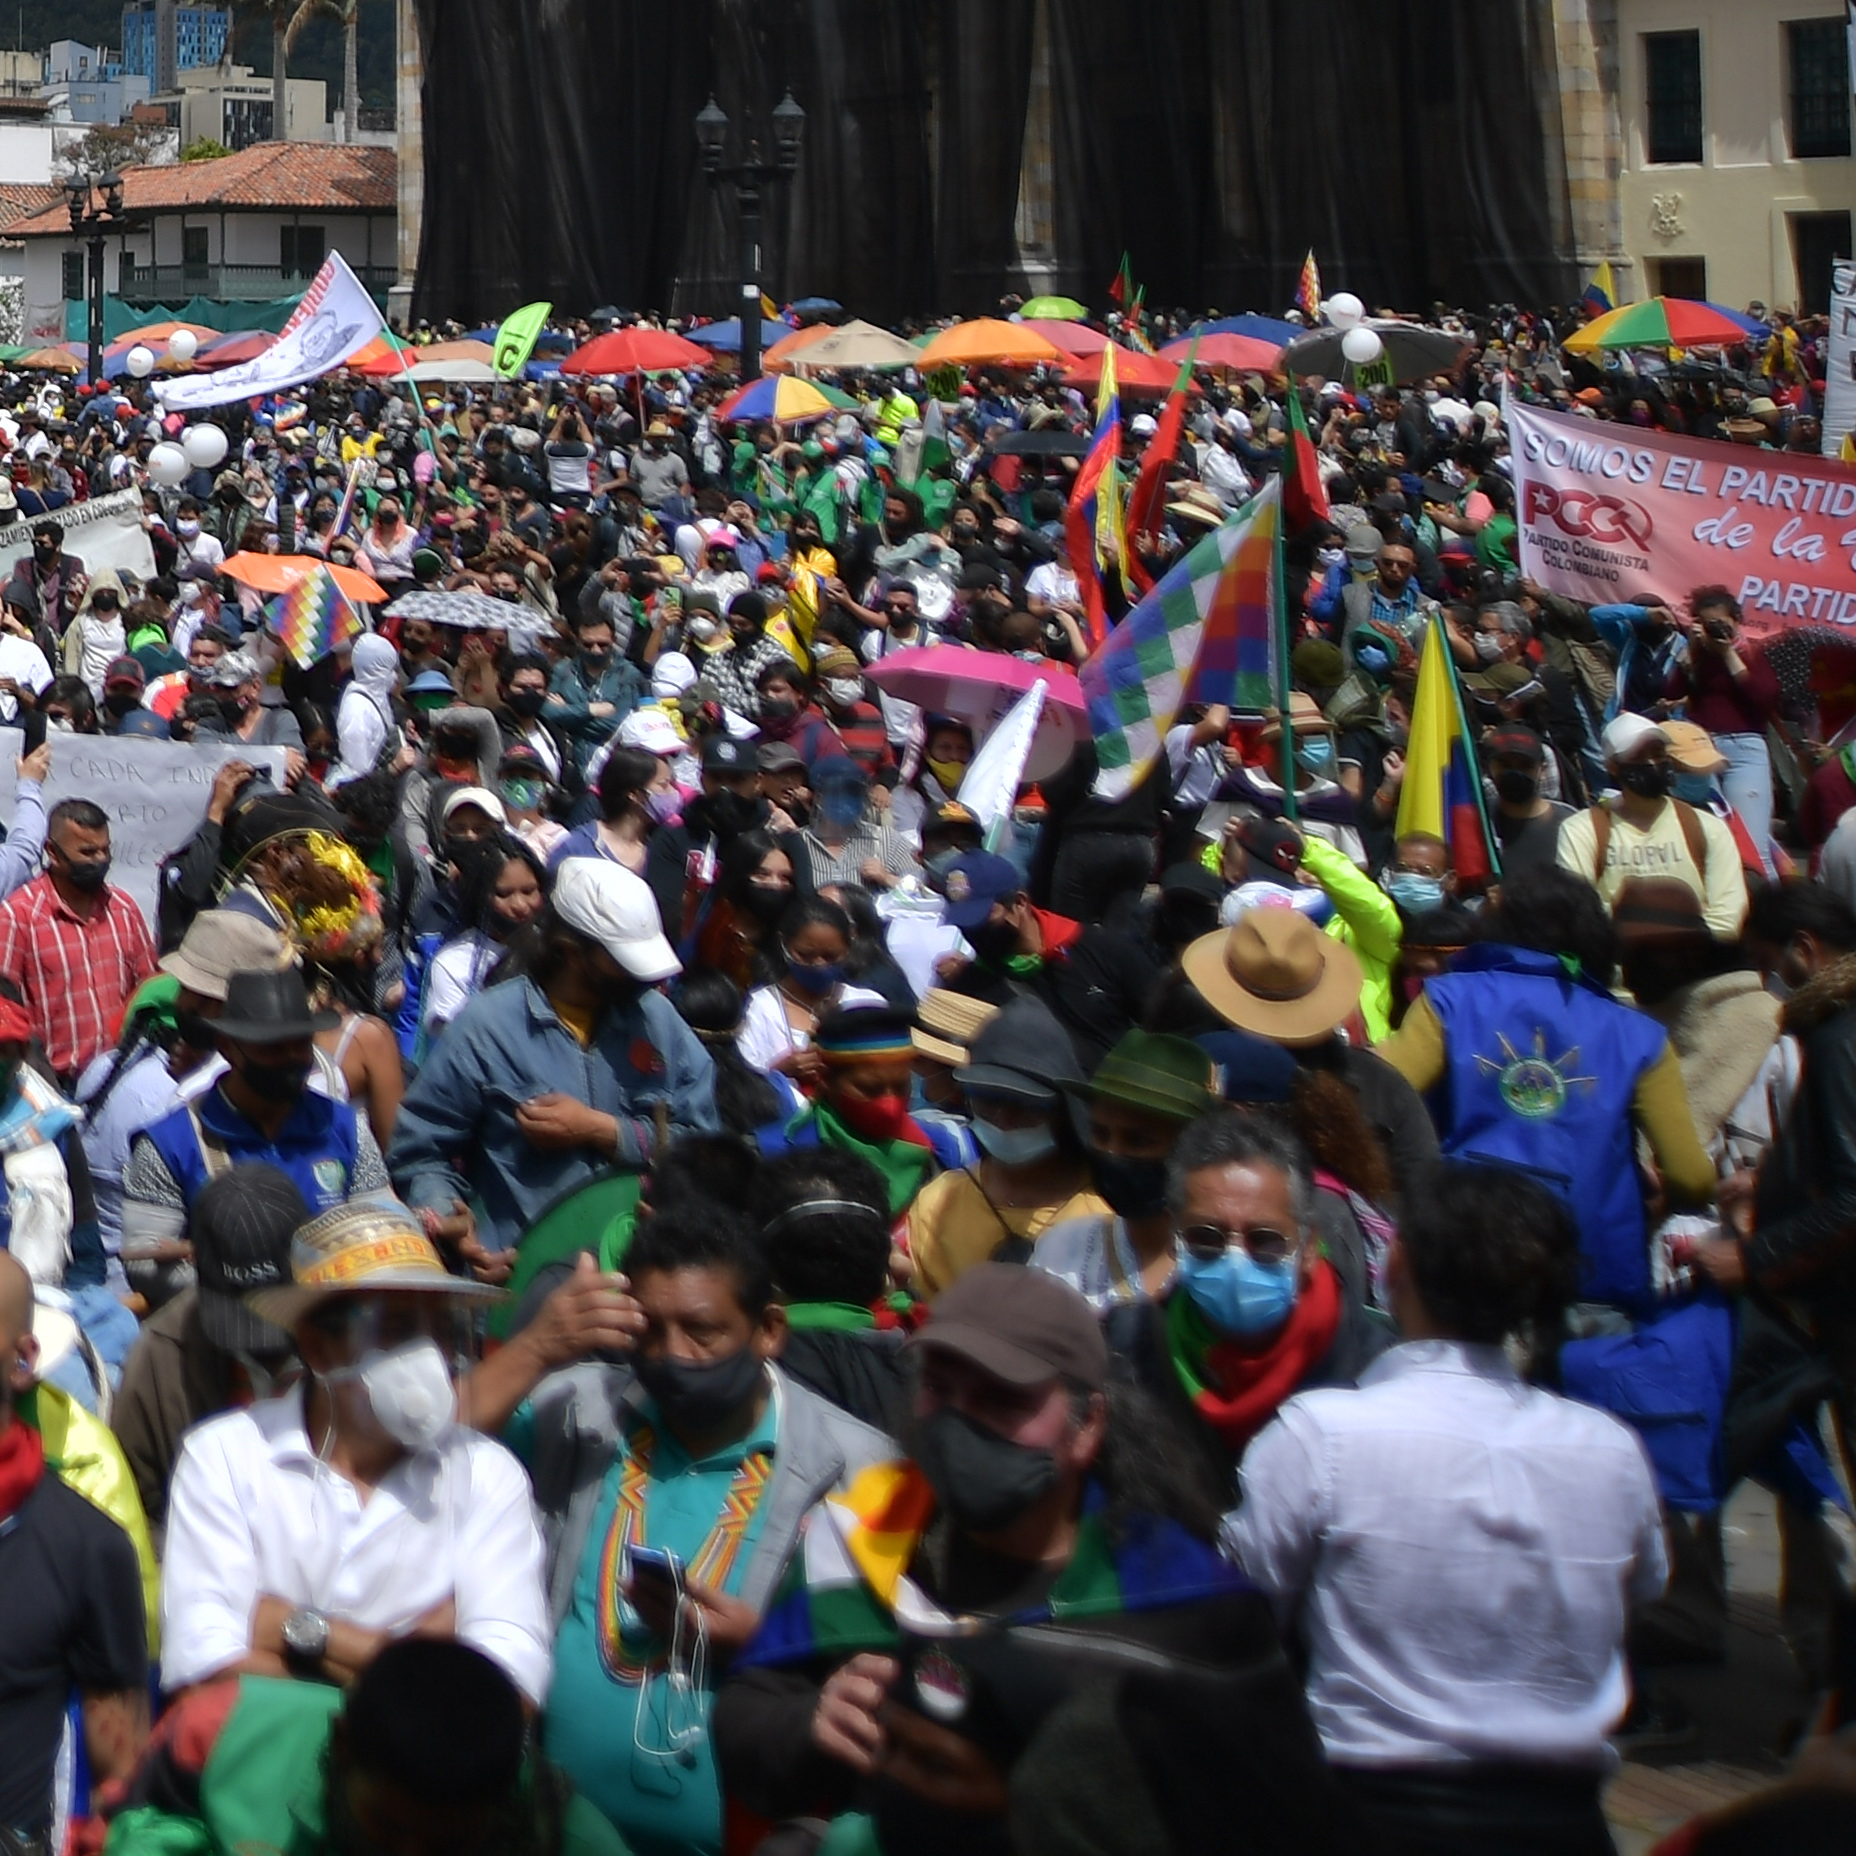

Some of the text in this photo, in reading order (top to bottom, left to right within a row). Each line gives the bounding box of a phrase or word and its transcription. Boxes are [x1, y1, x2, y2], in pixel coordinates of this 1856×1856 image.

[1523, 430, 1656, 484] SOMOS
[1660, 455, 1708, 496] EL
[1523, 528, 1650, 573] PARTIDO COMUNISTA
[1692, 505, 1827, 563] de la
[1541, 548, 1620, 584] COLOMBIANO
[68, 755, 146, 786] CADA
